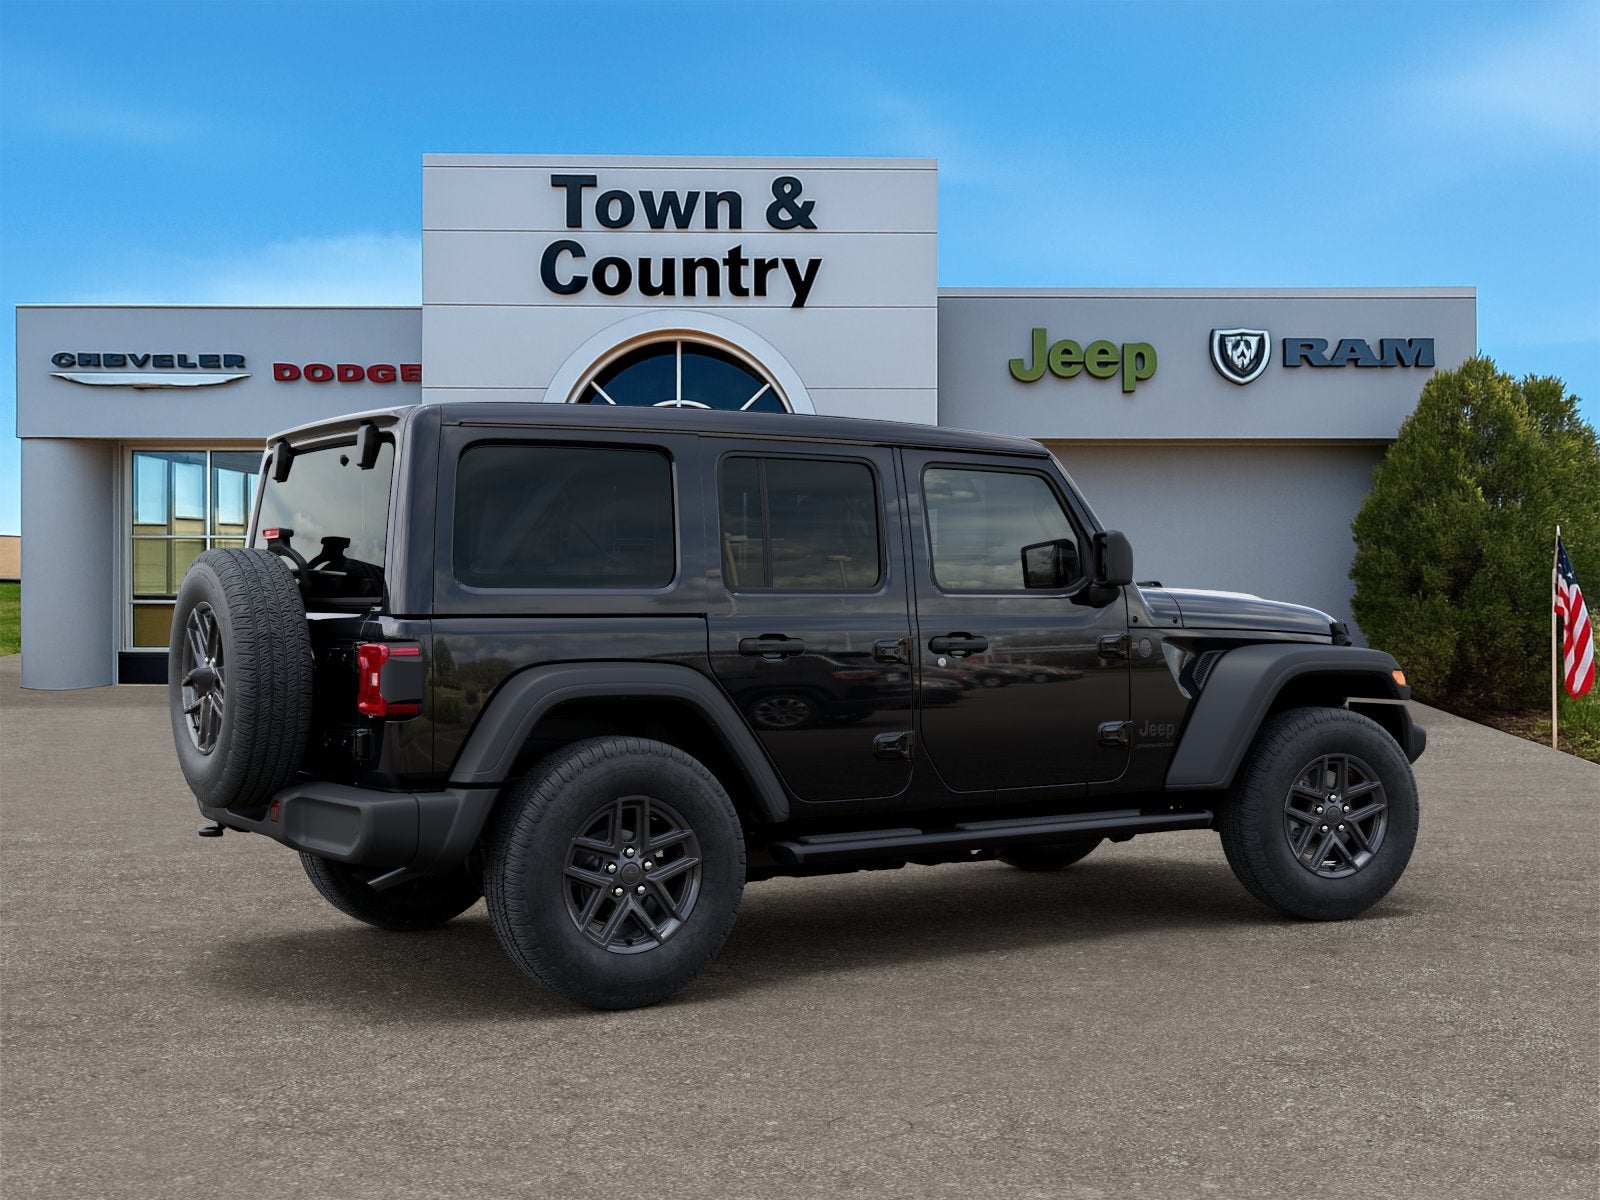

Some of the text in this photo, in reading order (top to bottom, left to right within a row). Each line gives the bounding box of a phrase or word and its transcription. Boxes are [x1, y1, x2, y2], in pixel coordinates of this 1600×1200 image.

[551, 174, 818, 230] Town &
[540, 239, 823, 308] Country
[272, 363, 422, 383] DODGE
[1008, 328, 1158, 393] Jeep
[1282, 337, 1436, 368] RAM
[1139, 719, 1175, 740] Jeep
